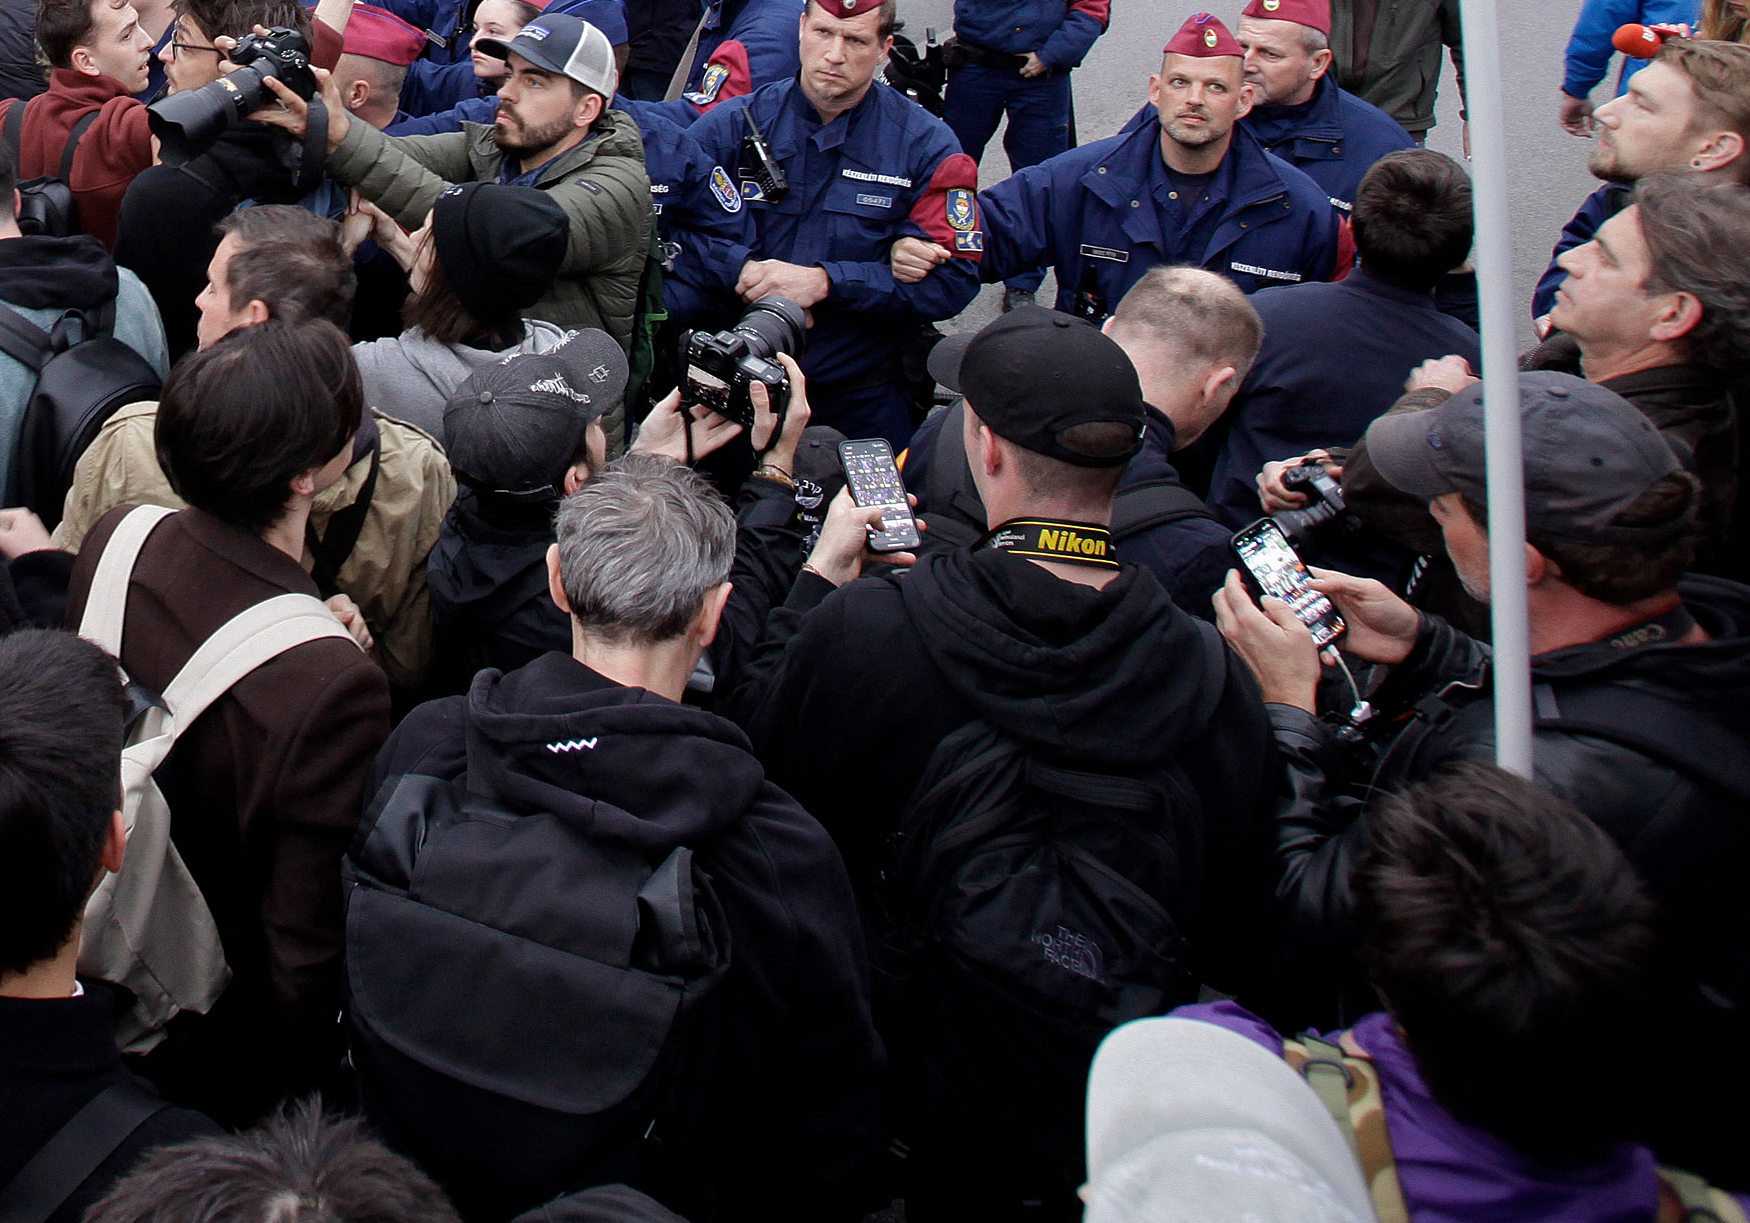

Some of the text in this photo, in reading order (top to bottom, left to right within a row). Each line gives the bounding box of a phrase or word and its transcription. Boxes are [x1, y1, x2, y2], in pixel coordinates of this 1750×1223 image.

[842, 168, 912, 188] KÉSZENLÉTI RENDŐRSÉG
[1038, 528, 1107, 556] Nikon
[1058, 925, 1088, 948] THE
[1044, 947, 1082, 972] FACE
